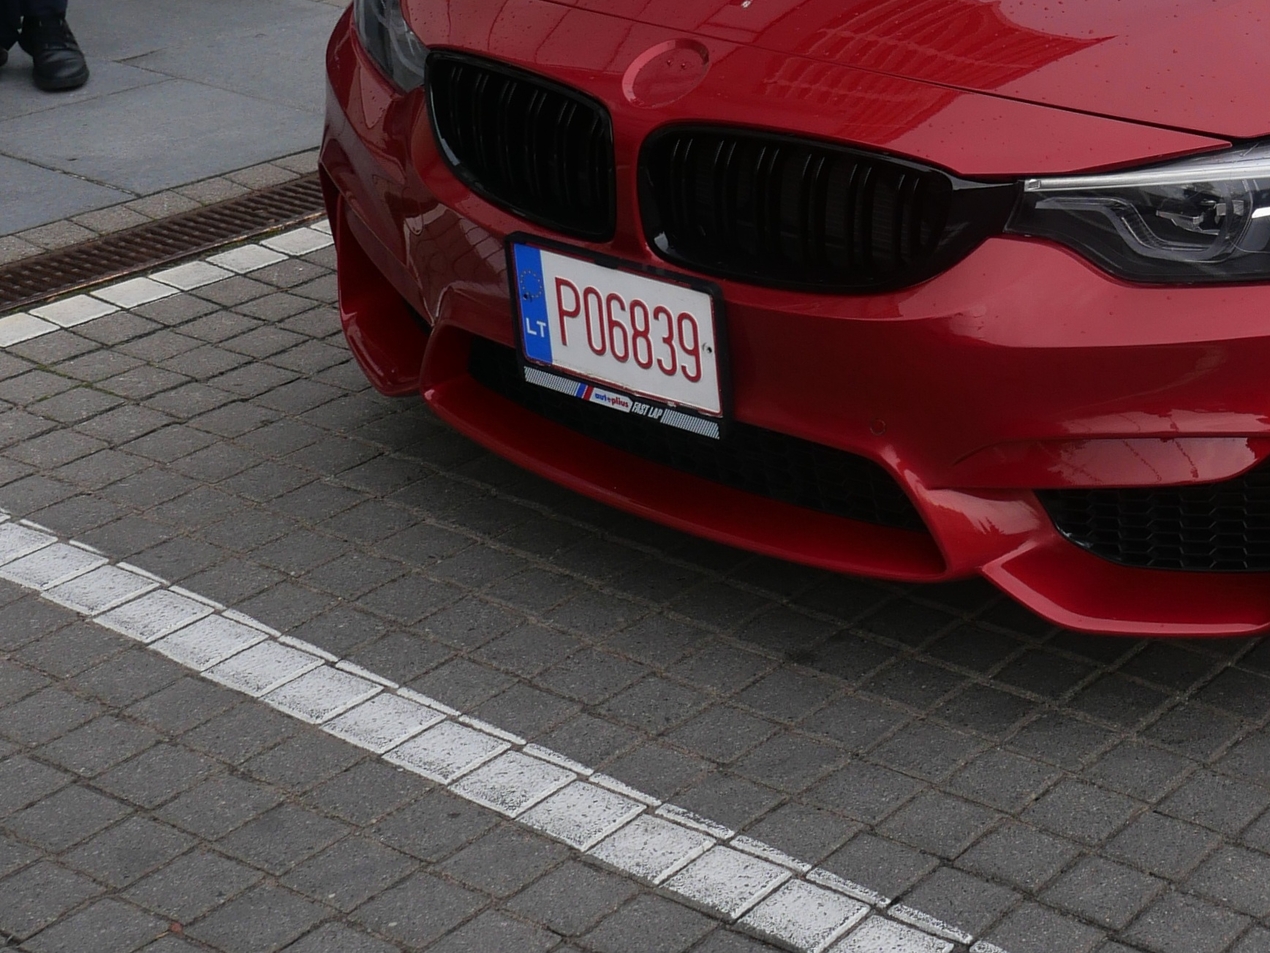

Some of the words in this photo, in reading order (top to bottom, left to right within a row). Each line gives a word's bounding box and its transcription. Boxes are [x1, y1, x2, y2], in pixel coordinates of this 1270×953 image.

[525, 317, 547, 338] LT
[554, 276, 702, 383] P06839
[632, 401, 650, 416] FAST
[648, 406, 663, 420] LAP
